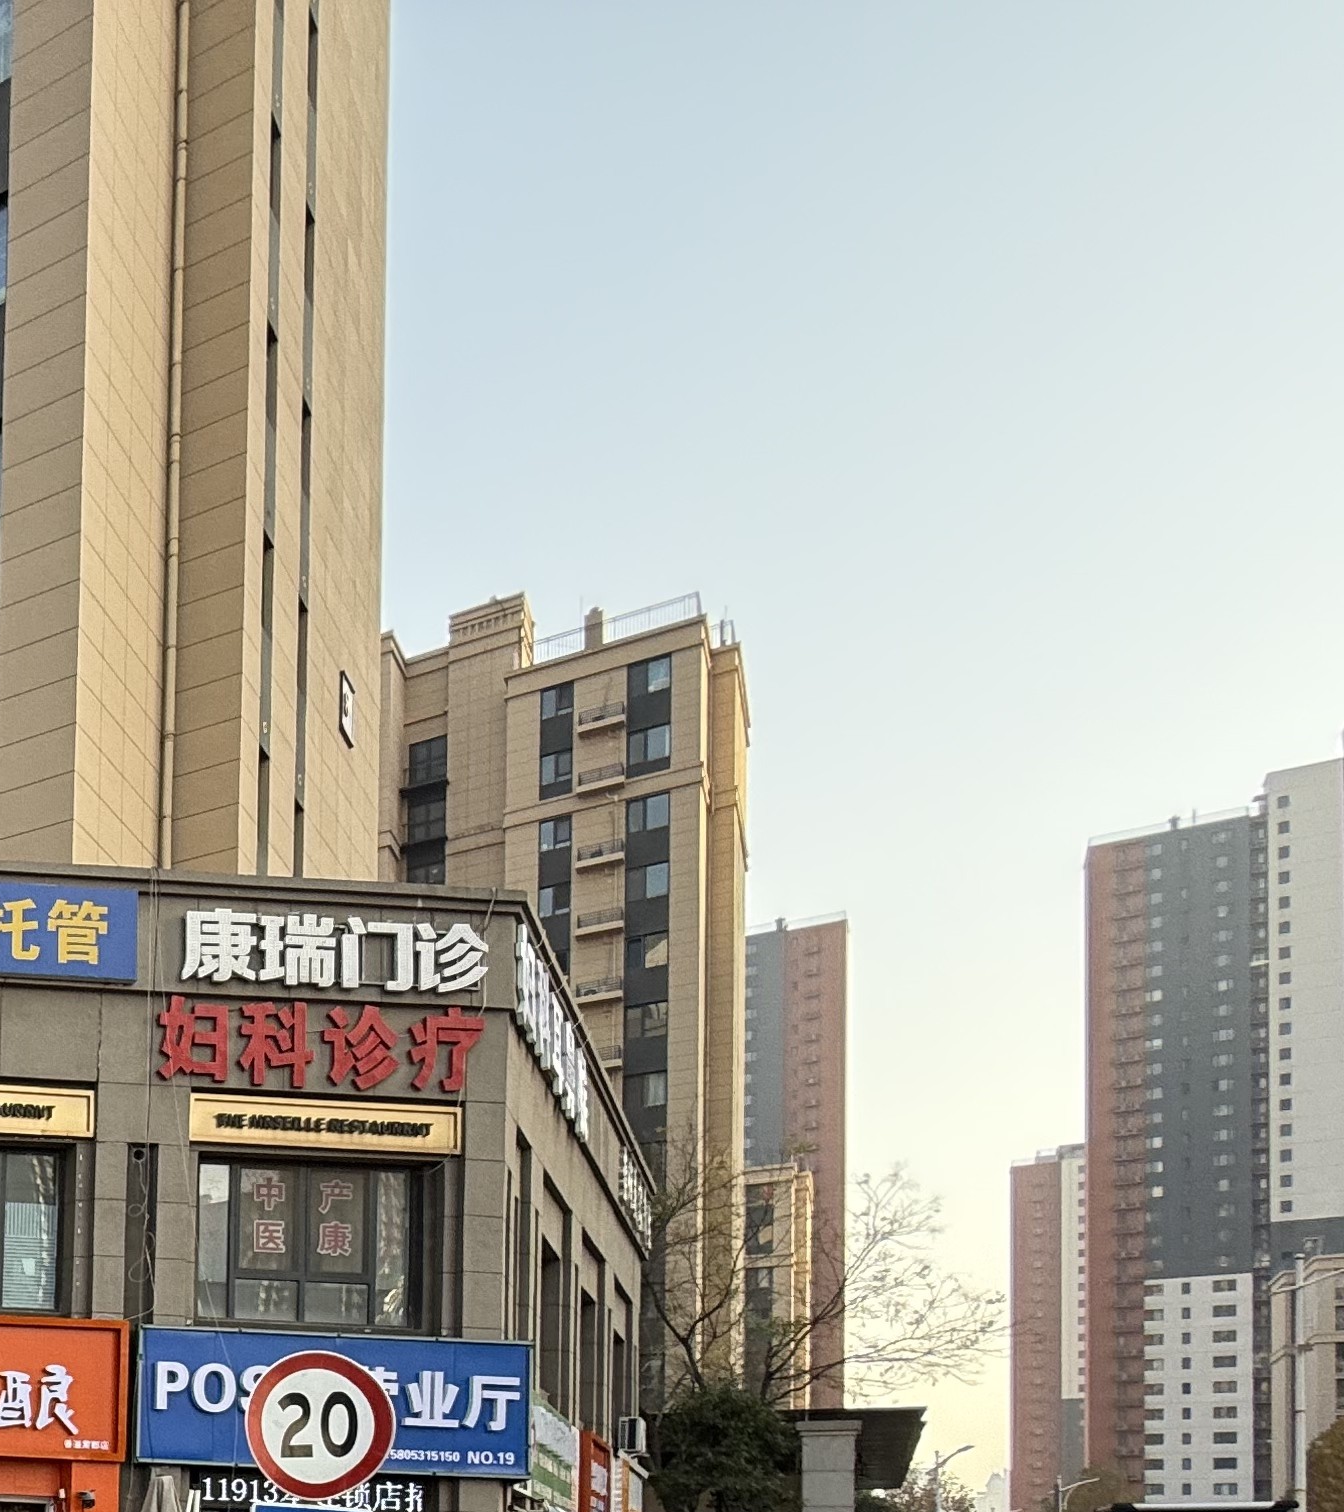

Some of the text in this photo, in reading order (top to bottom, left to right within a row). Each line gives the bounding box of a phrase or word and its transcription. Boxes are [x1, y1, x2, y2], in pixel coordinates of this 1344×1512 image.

[180, 908, 489, 992] 康瑞门诊
[158, 996, 486, 1092] 妇科诊疗
[214, 1113, 247, 1128] THE
[253, 1177, 285, 1253] 中医
[317, 1179, 353, 1256] 产康
[278, 1391, 358, 1458] 20
[467, 1450, 515, 1466] NO.19
